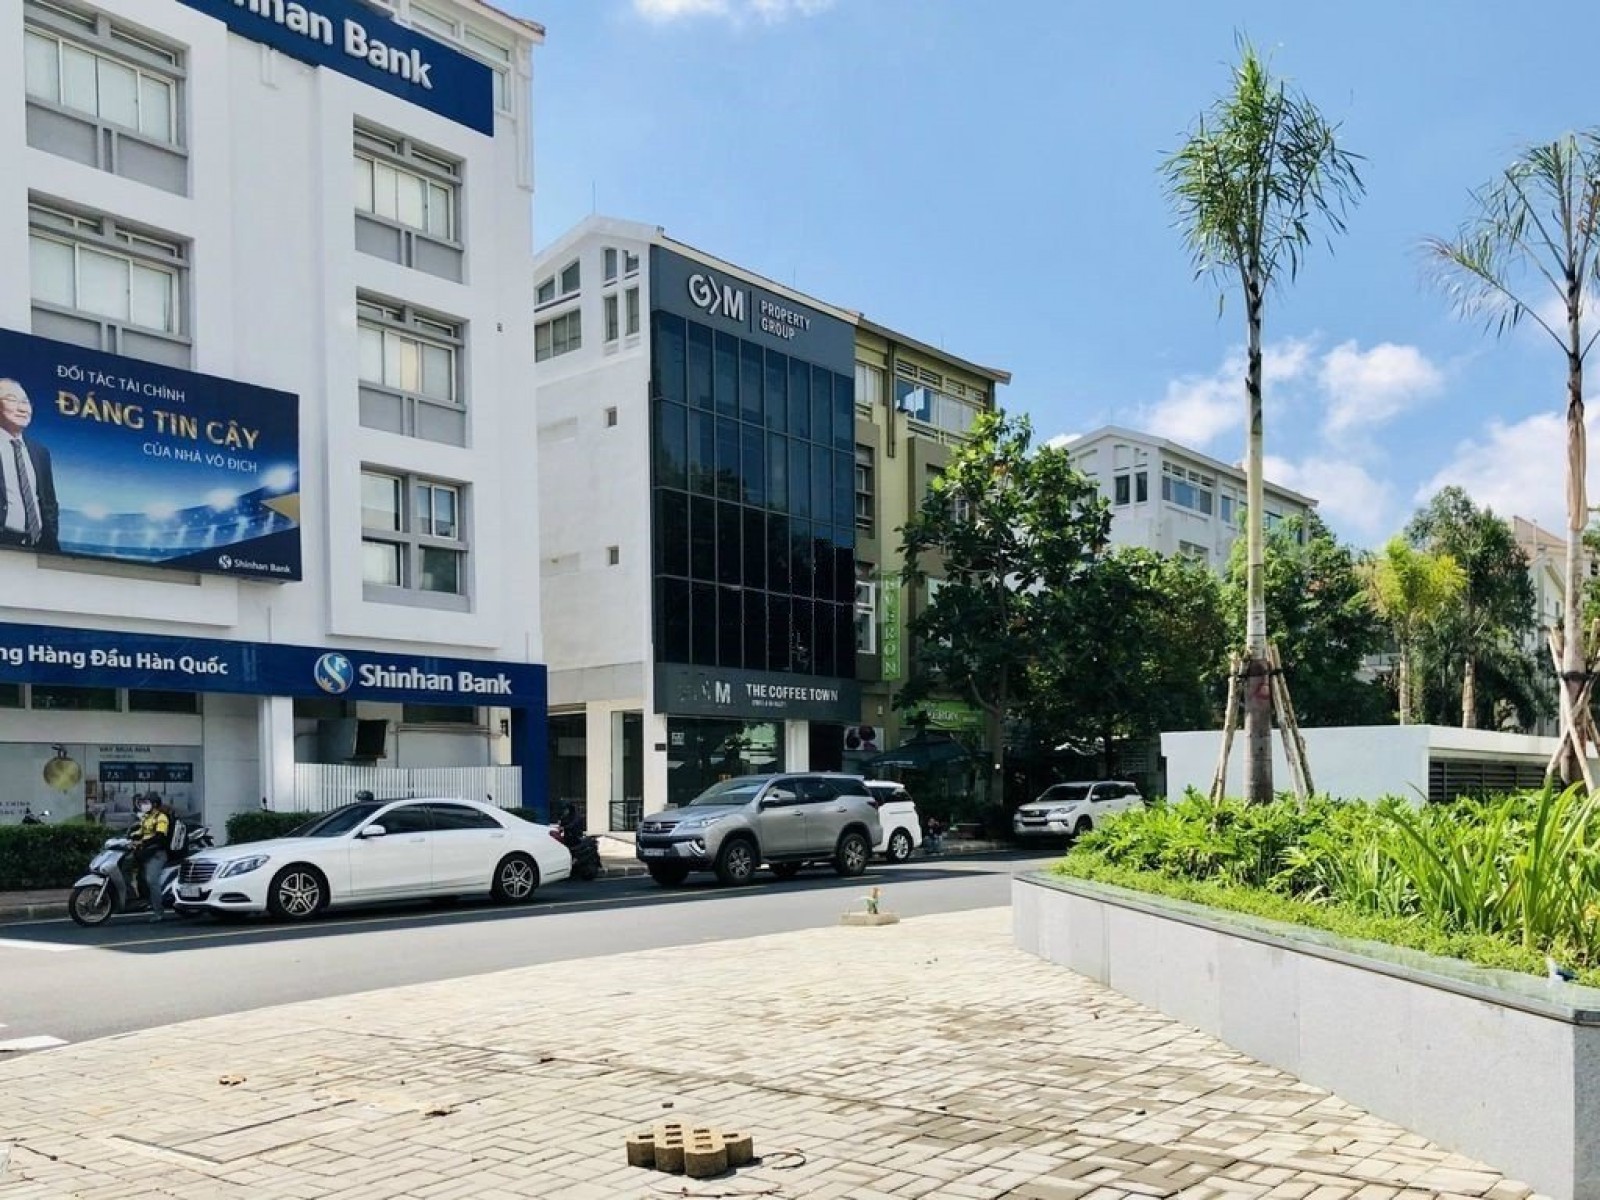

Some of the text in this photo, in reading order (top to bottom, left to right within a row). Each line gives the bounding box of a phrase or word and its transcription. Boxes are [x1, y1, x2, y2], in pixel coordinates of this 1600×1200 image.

[343, 18, 433, 90] Bank
[760, 300, 811, 331] PROPERTY
[760, 317, 795, 340] GROUP
[57, 364, 84, 382] ĐỐI
[55, 390, 259, 451] ĐÁNG TIN CẬY
[143, 441, 171, 457] CỦA
[205, 455, 224, 468] VÔ
[234, 559, 292, 573] Shinhan Bank
[27, 644, 86, 669] Hàng
[90, 648, 132, 669] Đầu
[136, 653, 175, 671] Hàn
[179, 655, 229, 675] Quốc
[359, 663, 512, 695] Shinhan Bank
[745, 683, 767, 698] THE
[768, 685, 807, 700] COFFEE
[809, 688, 839, 702] TOWN
